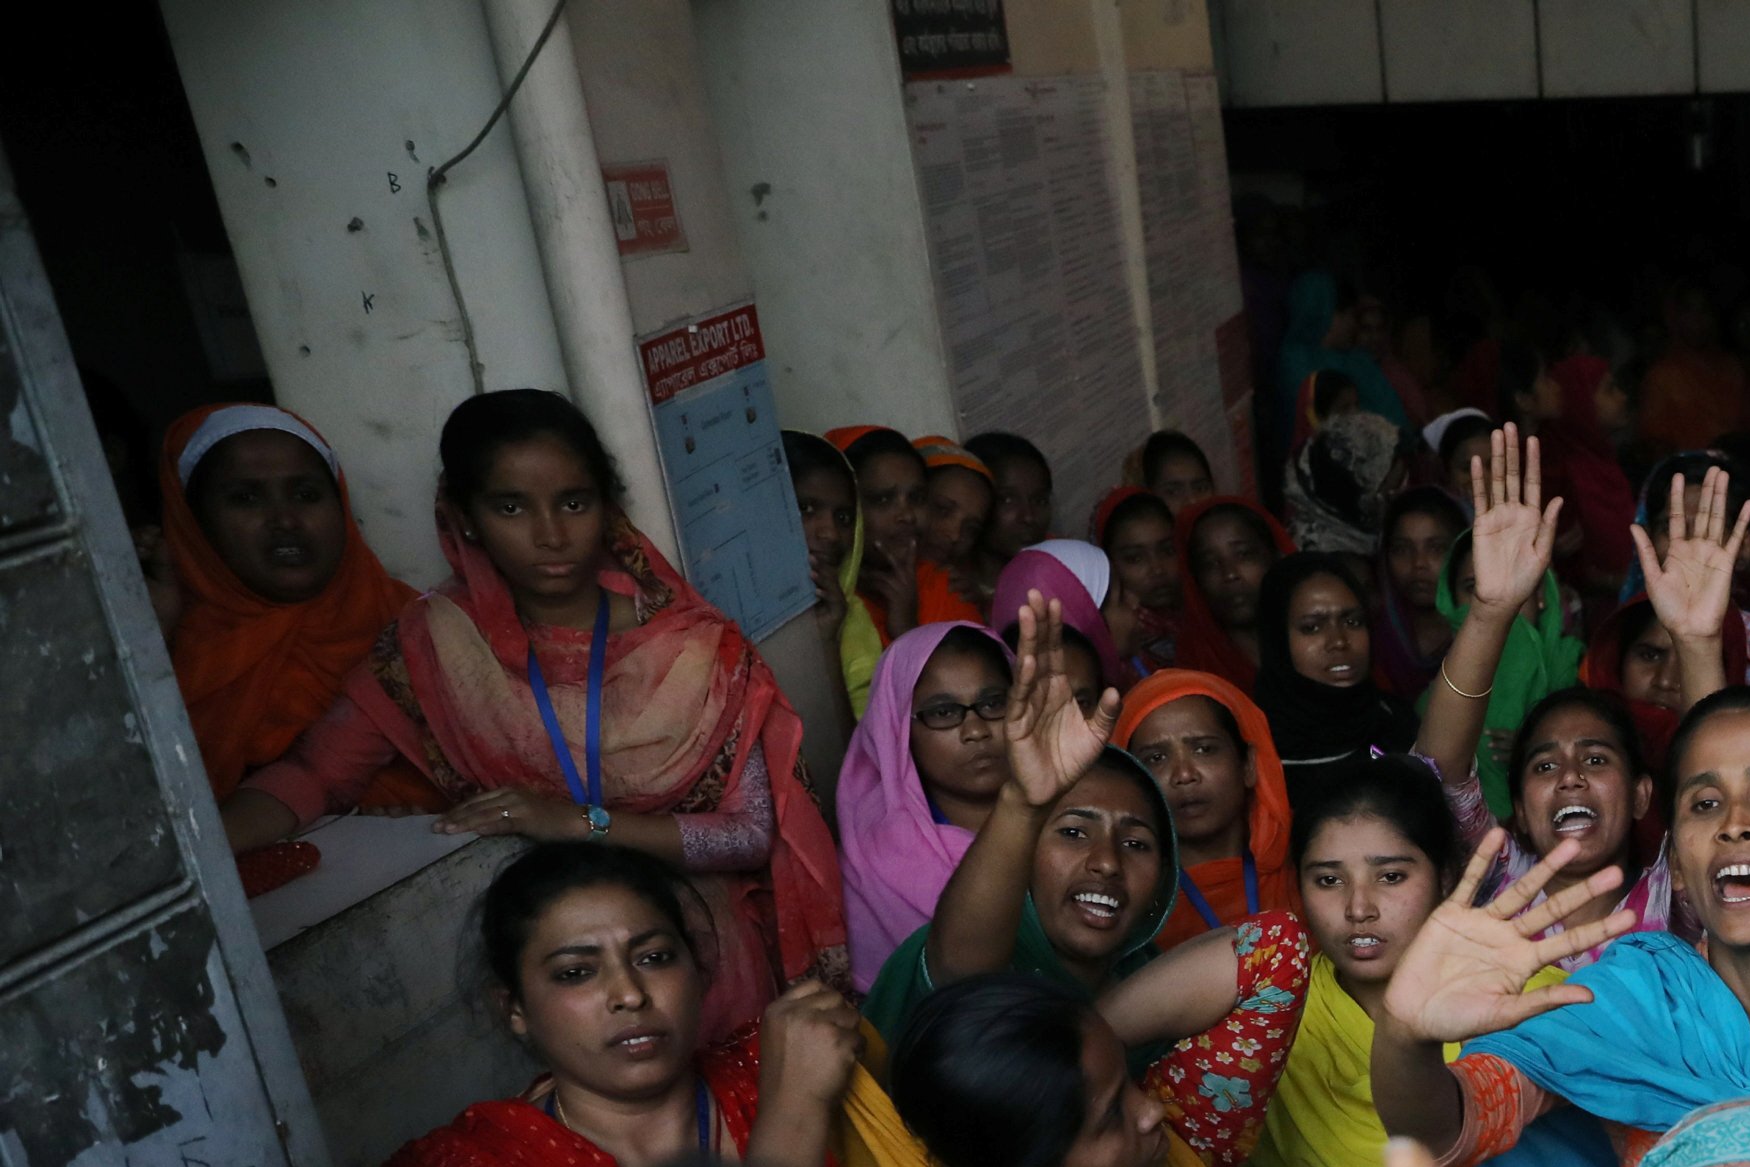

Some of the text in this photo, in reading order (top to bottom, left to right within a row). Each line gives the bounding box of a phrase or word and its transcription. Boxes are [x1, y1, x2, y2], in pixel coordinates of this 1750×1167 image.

[387, 172, 401, 194] B
[361, 290, 375, 314] K
[647, 314, 754, 375] APPAREL EXPORT LTD.
